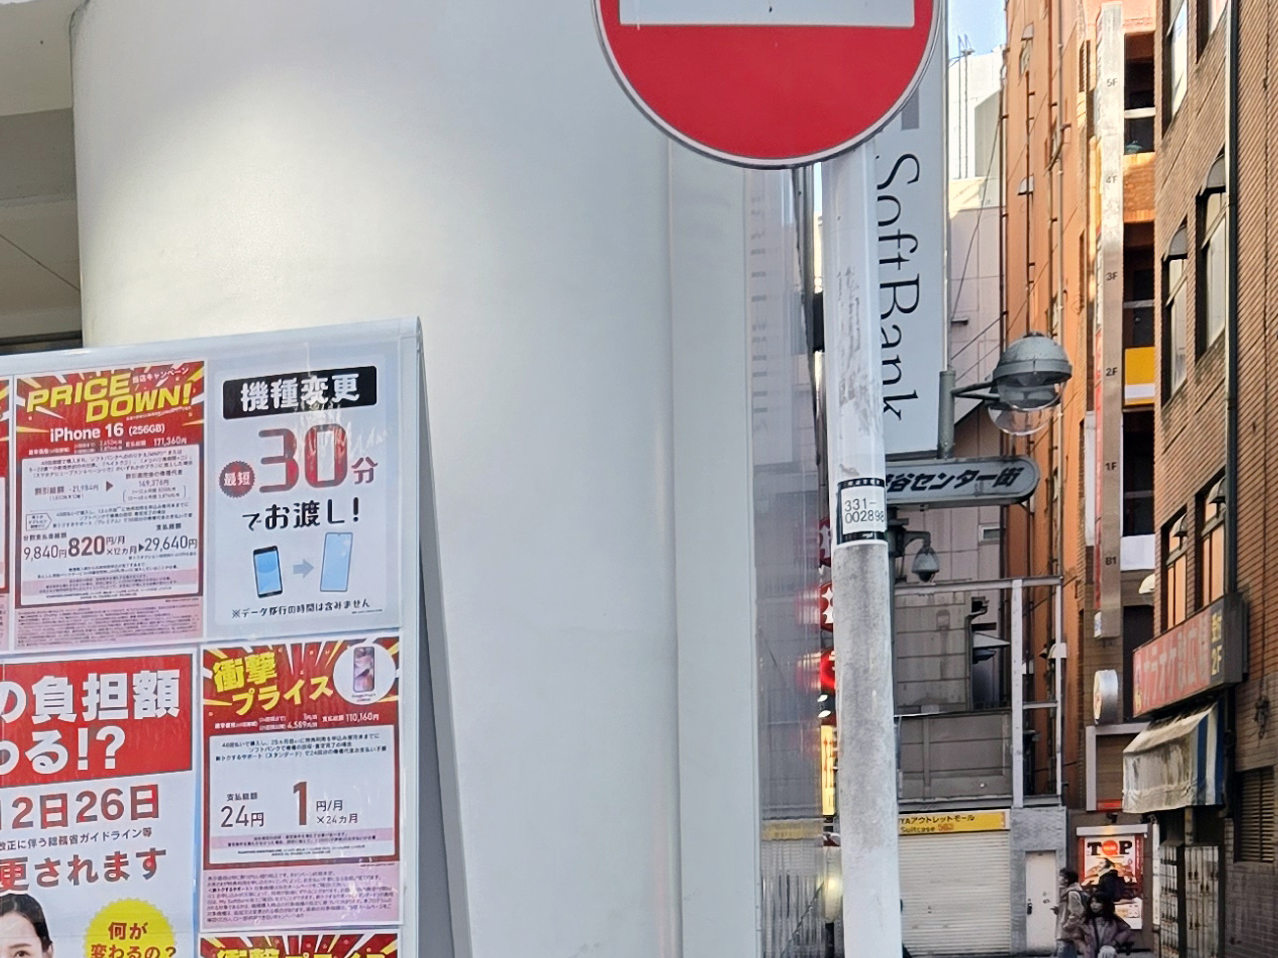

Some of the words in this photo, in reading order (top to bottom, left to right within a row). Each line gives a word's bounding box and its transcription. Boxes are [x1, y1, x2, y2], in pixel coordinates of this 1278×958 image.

[1106, 272, 1118, 281] 3F
[1106, 367, 1118, 376] 2F
[27, 372, 132, 413] PRICE
[240, 372, 360, 412] 機種変更
[85, 382, 193, 423] DOWN!
[50, 427, 101, 443] iPhone
[105, 423, 124, 438] 16
[128, 424, 165, 437] (256GB)
[1105, 462, 1117, 471] 1F
[223, 471, 251, 487] 最短
[886, 467, 1025, 493] 谷センター街
[23, 544, 68, 562] 9,840円
[68, 535, 105, 557] 820
[144, 535, 198, 552] 29,640円
[1105, 556, 1117, 566] B1
[212, 651, 278, 693] 衝撃
[232, 675, 334, 716] プライス
[345, 712, 380, 722] 110,160円
[293, 781, 307, 826] 1
[316, 799, 343, 812] 円/月
[220, 805, 264, 828] 24円
[107, 922, 148, 940] 何が
